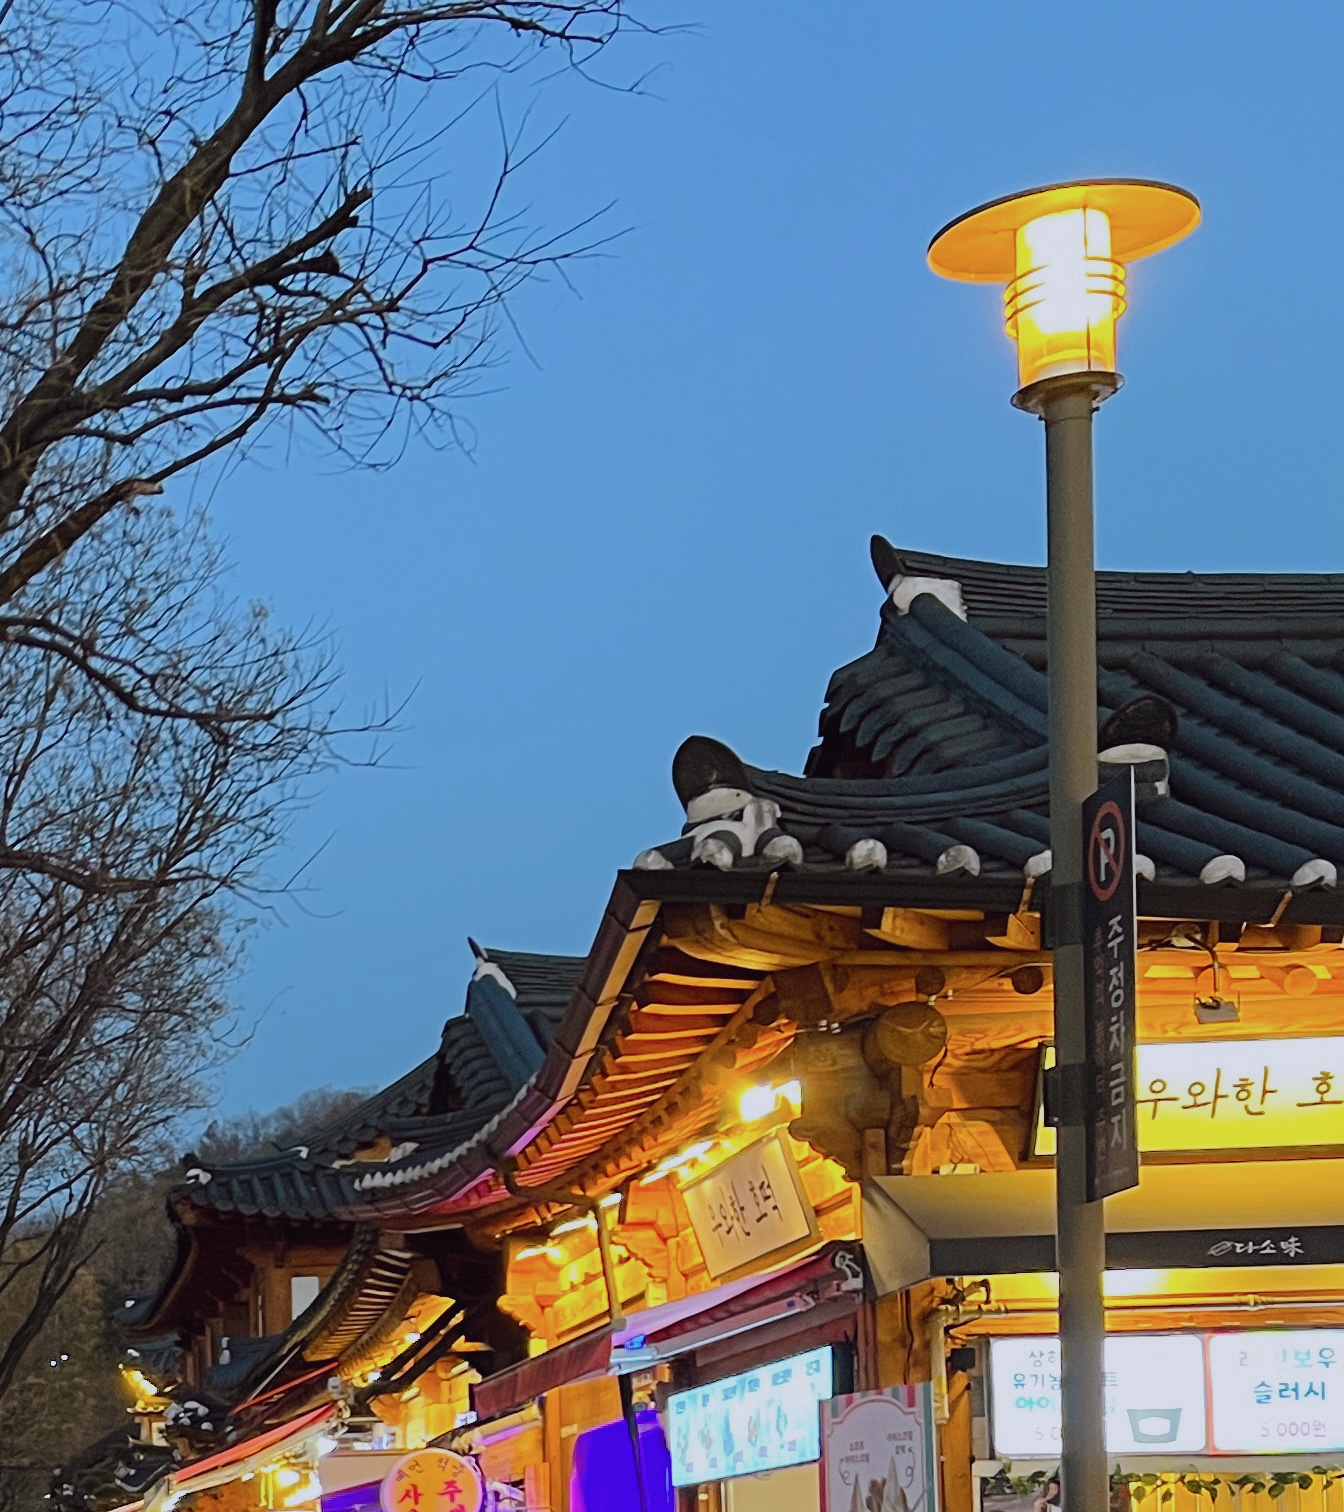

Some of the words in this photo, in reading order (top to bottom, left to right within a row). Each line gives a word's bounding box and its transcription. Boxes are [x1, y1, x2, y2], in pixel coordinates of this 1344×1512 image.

[1107, 913, 1127, 1054] 주정차
[1109, 1061, 1128, 1151] 금지
[1136, 1065, 1279, 1121] 우와한
[708, 1180, 751, 1248] 우와한
[749, 1163, 783, 1223] 호떡
[1253, 1380, 1326, 1405] 슬러시
